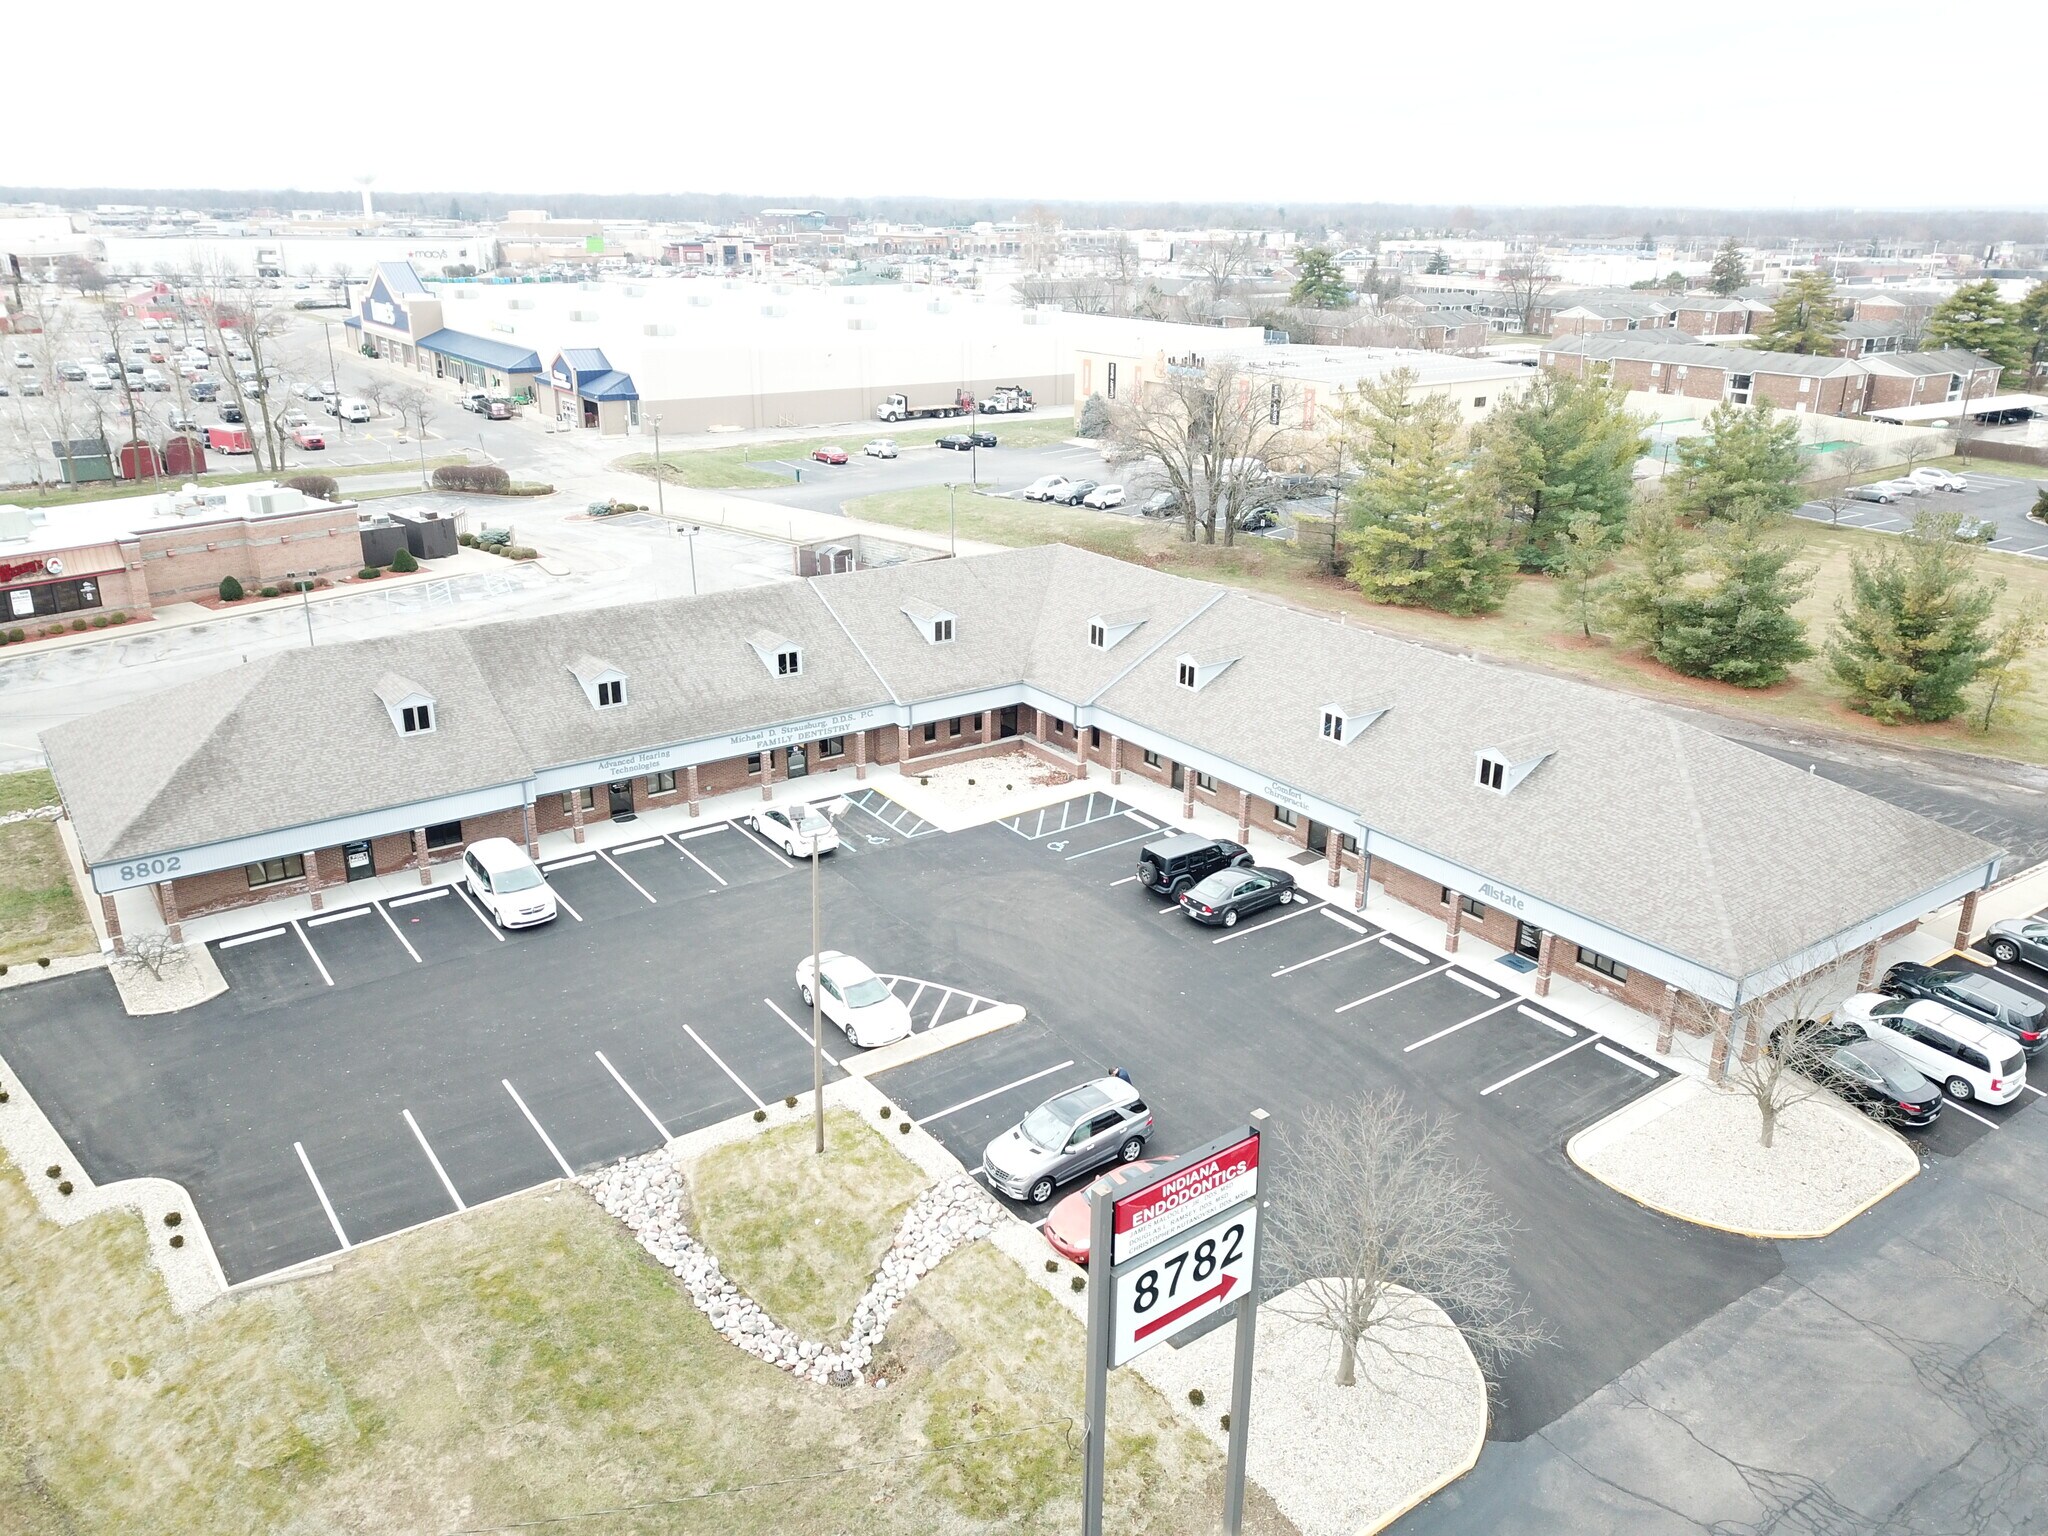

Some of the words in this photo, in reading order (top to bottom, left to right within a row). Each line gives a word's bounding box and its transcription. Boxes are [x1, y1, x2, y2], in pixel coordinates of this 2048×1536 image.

[730, 731, 764, 744] Michael
[756, 735, 794, 749] FAMILY
[798, 724, 851, 741] DENTISTRY
[598, 756, 635, 770] Advanced
[637, 750, 671, 762] Hearing
[610, 761, 660, 775] Technologies
[1264, 786, 1310, 810] Chiropractic
[1272, 782, 1302, 800] Comfort
[120, 856, 181, 881] 8802
[1478, 883, 1525, 910] Allstate
[1162, 1161, 1220, 1197] INDIANA
[1132, 1160, 1247, 1227] ENDODONTICS
[1128, 1227, 1175, 1254] CHRISTOPHER
[1129, 1227, 1161, 1246] DOUGLAS
[1130, 1223, 1152, 1238] JAMES
[1133, 1224, 1245, 1313] 8782
